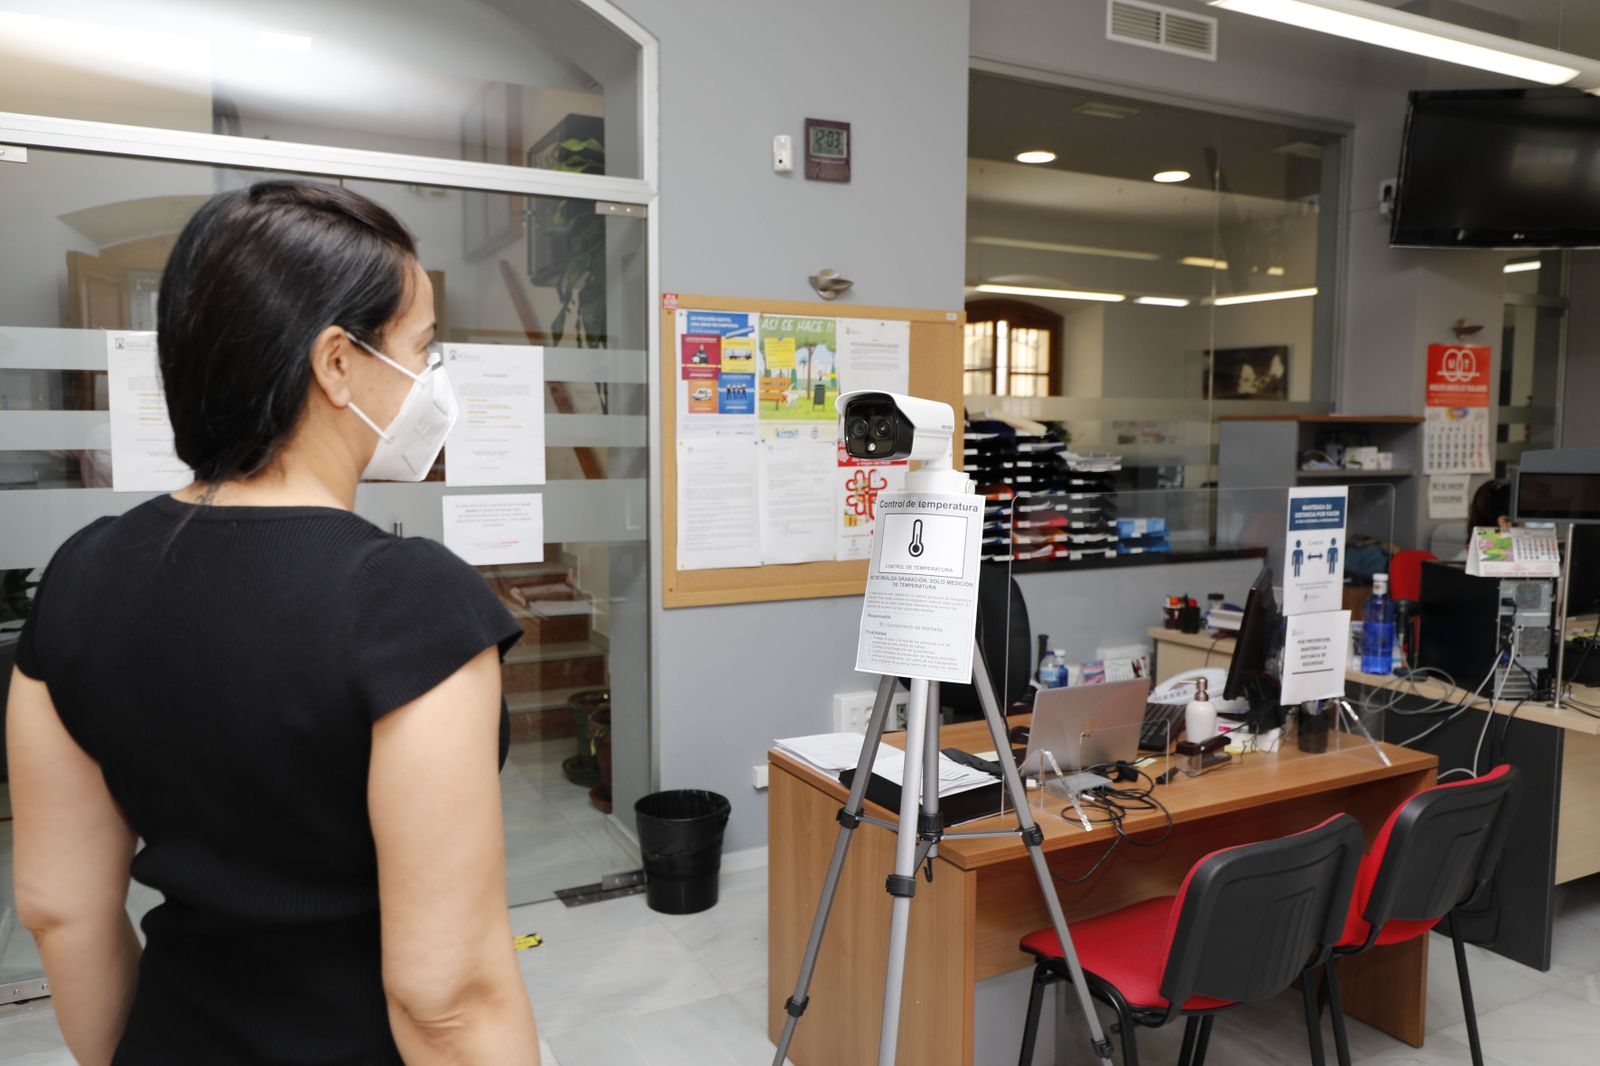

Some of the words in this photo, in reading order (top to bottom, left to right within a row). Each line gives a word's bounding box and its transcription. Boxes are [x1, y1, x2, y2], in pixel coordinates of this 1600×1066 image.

[781, 319, 794, 331] SE
[796, 320, 824, 333] HACE
[879, 500, 905, 509] Control
[906, 500, 916, 508] de
[918, 500, 979, 512] temperatura
[914, 565, 954, 573] TEMPERATURA
